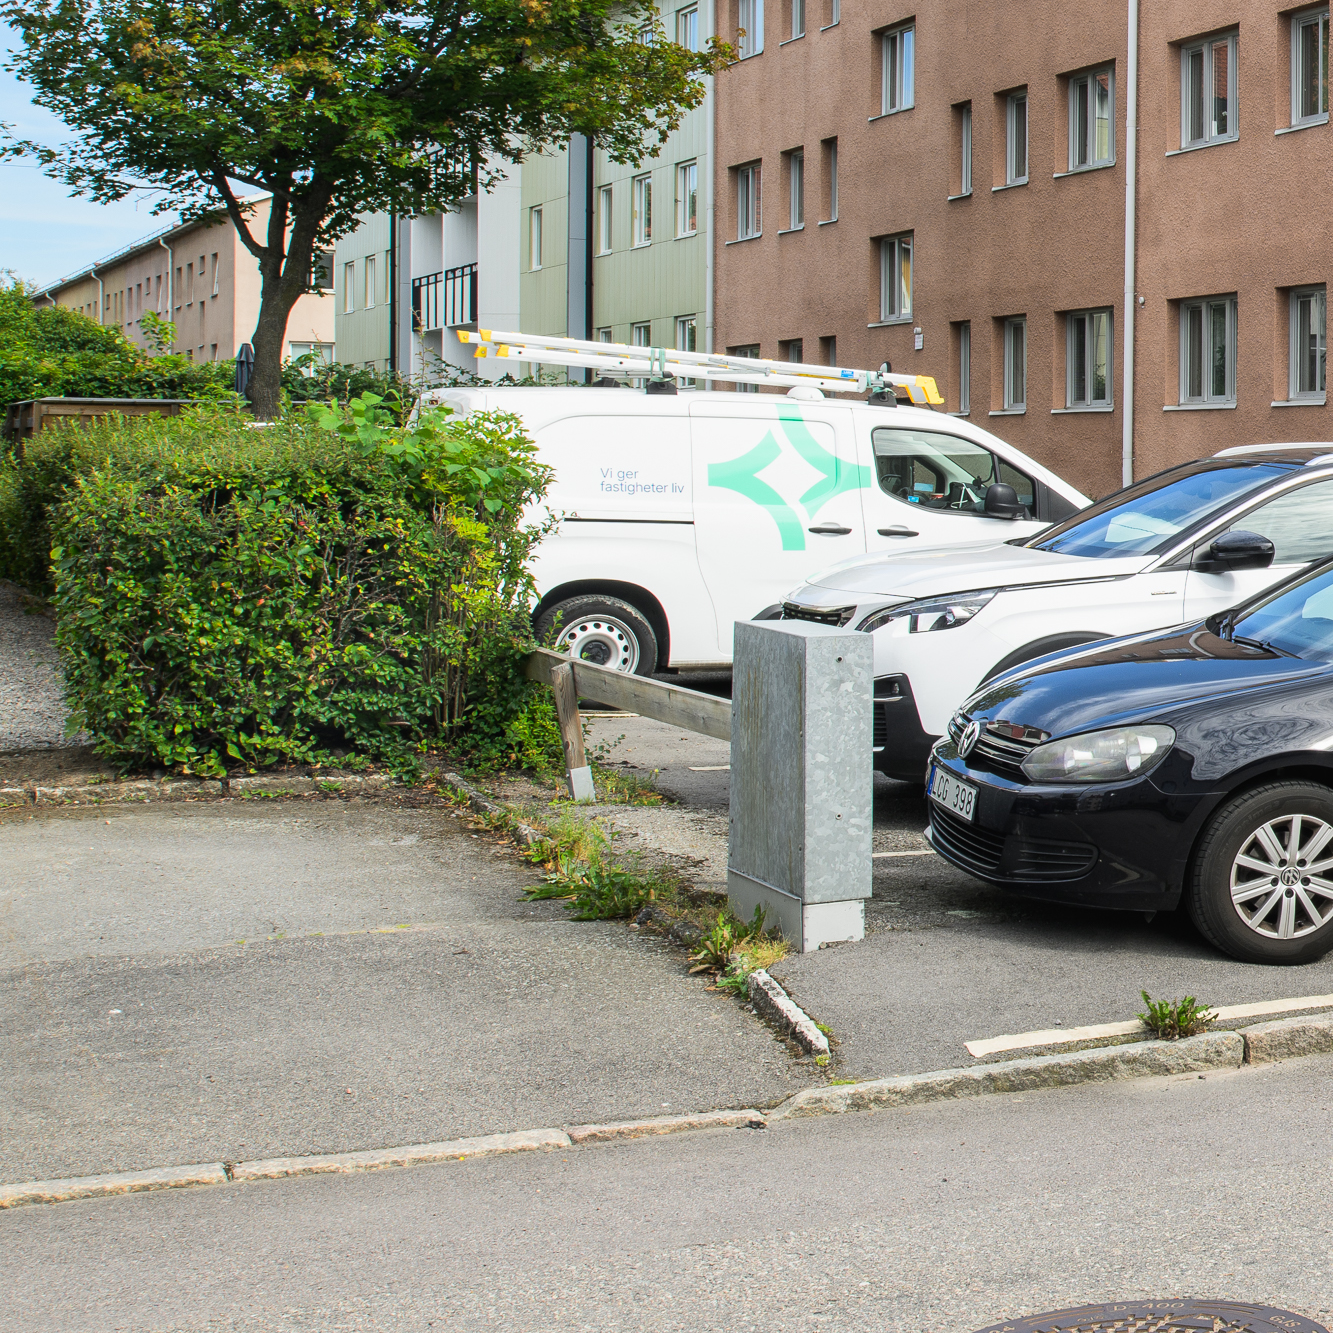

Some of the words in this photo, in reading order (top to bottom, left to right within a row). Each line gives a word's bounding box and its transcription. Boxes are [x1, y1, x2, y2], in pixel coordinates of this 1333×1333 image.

[600, 467, 613, 479] Vi
[617, 470, 639, 482] ger
[600, 480, 668, 495] fastigheter
[671, 483, 685, 494] liv
[932, 771, 950, 801] LCG
[953, 784, 973, 815] 398
